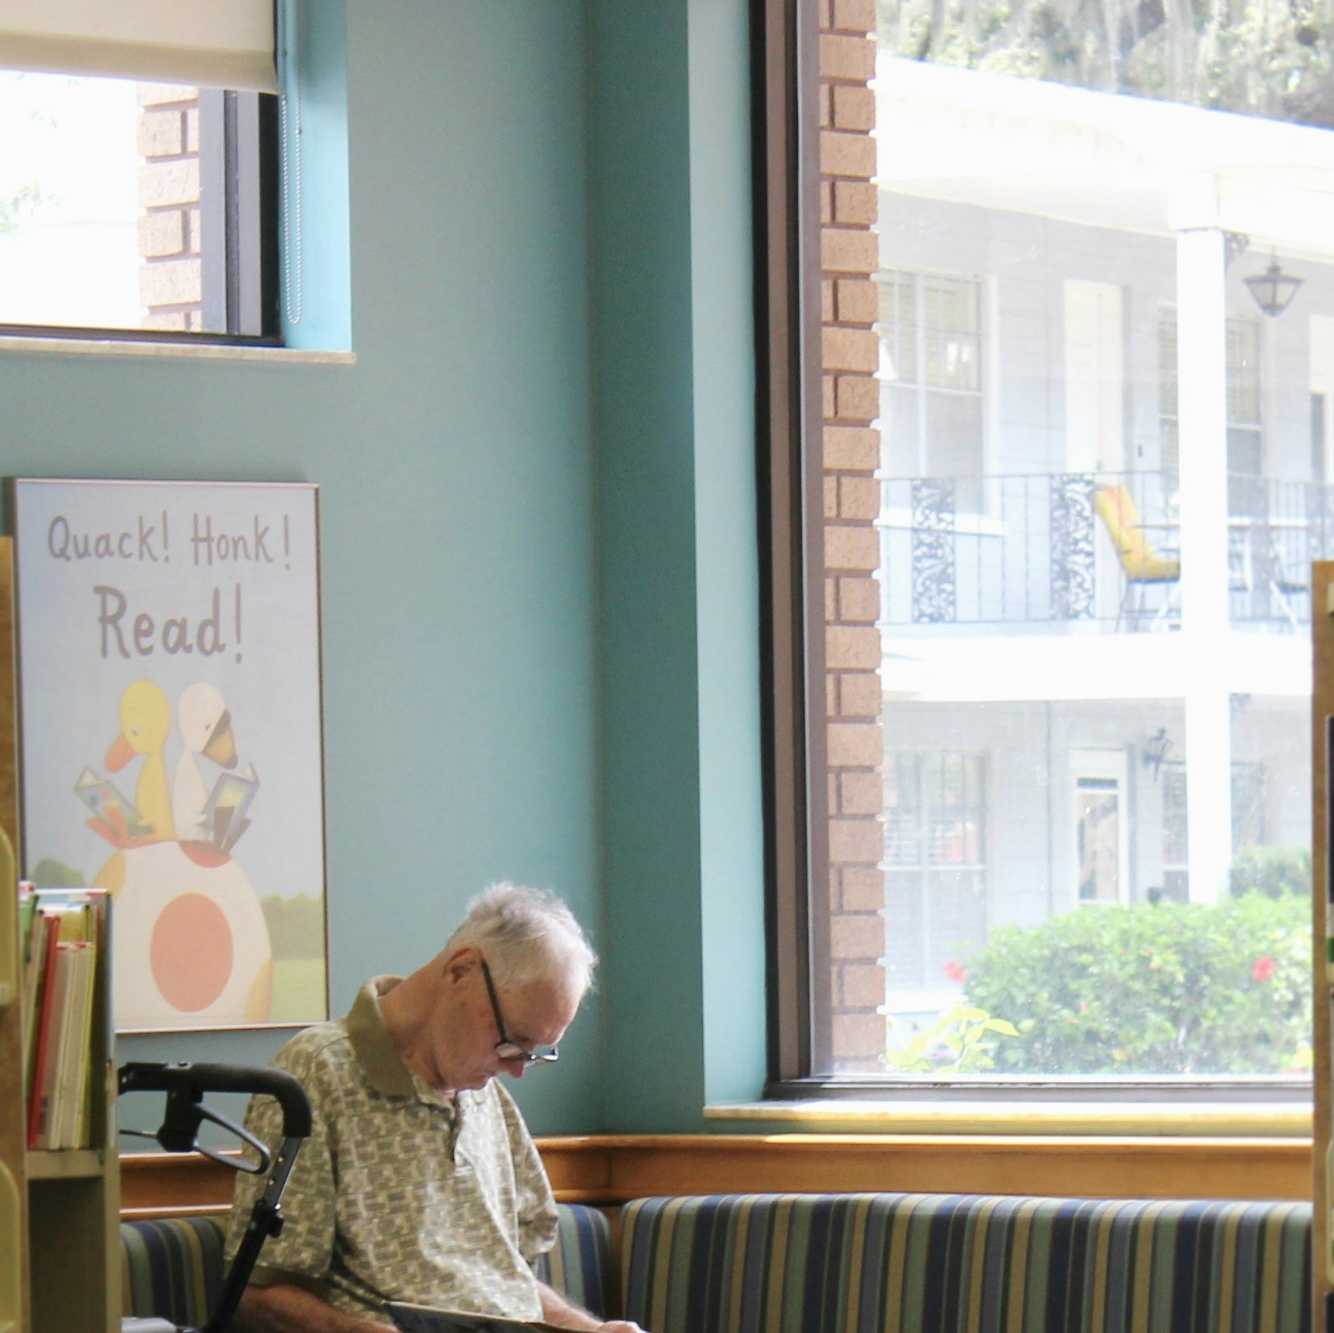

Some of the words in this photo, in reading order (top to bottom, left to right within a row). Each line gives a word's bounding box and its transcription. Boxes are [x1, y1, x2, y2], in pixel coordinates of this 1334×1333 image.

[48, 510, 169, 564] Quack!
[191, 512, 290, 570] Honk!
[93, 582, 242, 664] Read!
